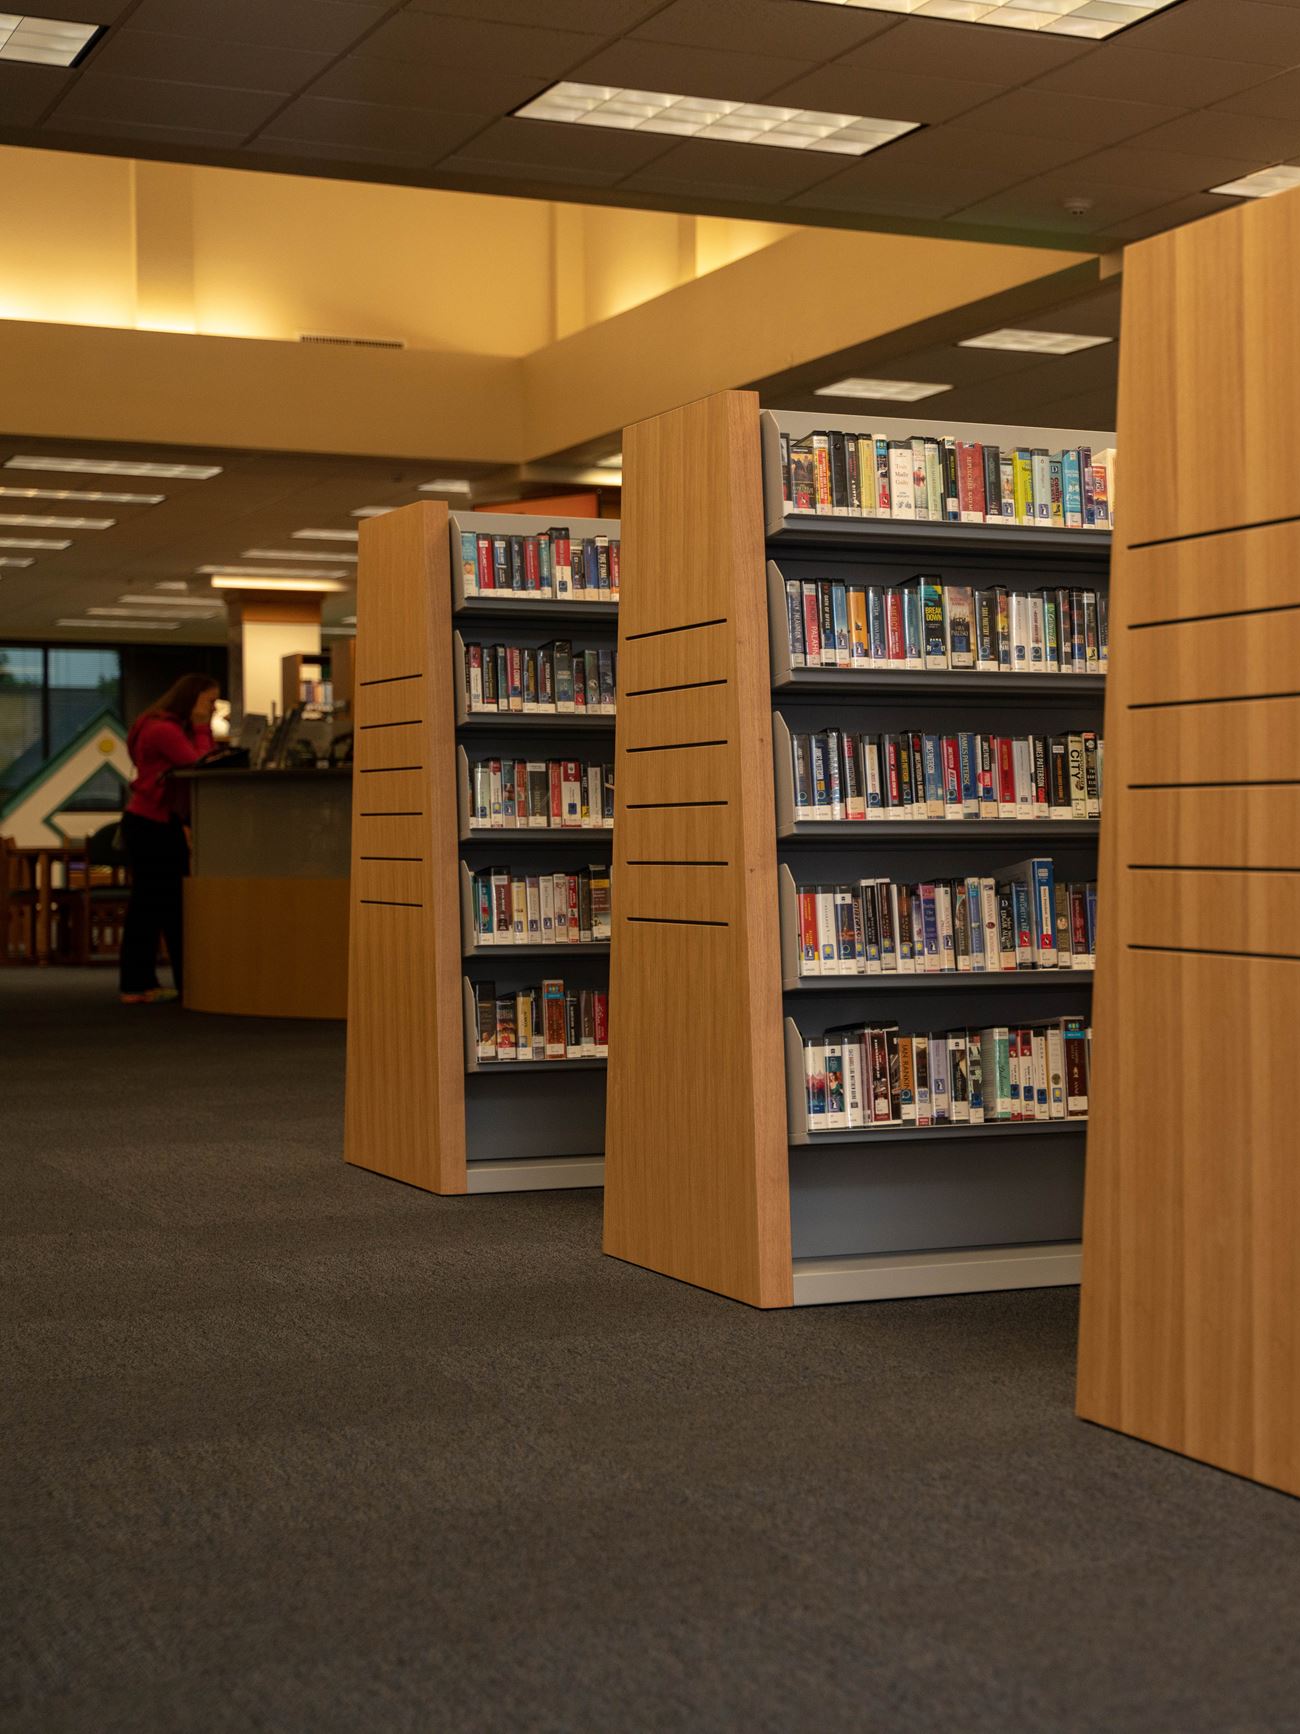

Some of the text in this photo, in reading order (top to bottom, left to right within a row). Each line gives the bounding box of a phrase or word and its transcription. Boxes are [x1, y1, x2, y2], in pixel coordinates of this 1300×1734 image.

[925, 606, 942, 614] BREAK
[926, 614, 942, 622] DOWN
[960, 735, 968, 754] JAMES
[1036, 758, 1044, 787] PATTERSON
[1071, 750, 1080, 779] CITY
[902, 1061, 910, 1090] RANKIN
